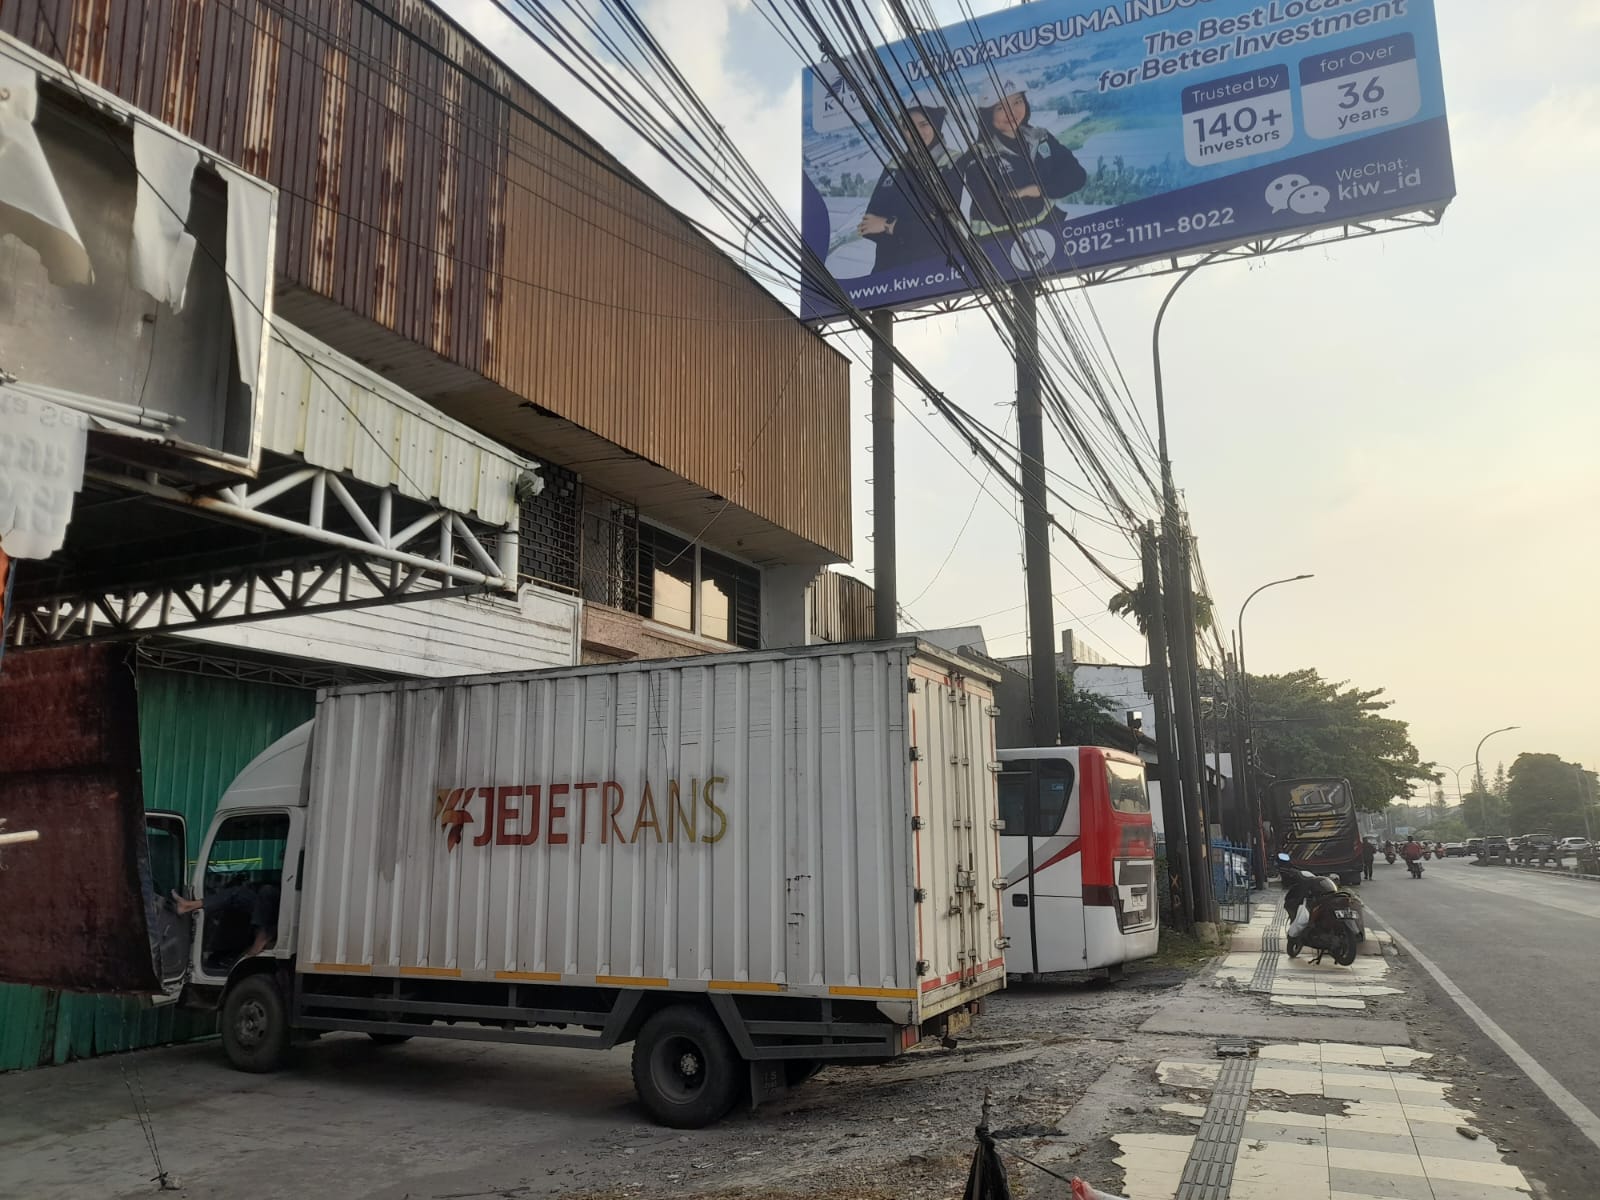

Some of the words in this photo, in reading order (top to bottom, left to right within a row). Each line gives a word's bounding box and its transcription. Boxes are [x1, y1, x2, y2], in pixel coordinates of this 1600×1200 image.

[1099, 68, 1139, 92] for
[1142, 44, 1231, 80] Better
[1236, 0, 1404, 57] Investment
[1146, 29, 1192, 55] The
[1200, 9, 1262, 40] Best
[1319, 58, 1345, 73] for
[1349, 45, 1395, 65] Over
[1192, 75, 1254, 104] Trusted
[1258, 74, 1280, 89] by
[1337, 76, 1385, 110] 36
[1193, 106, 1282, 142] 140+
[1337, 105, 1389, 130] years
[1199, 128, 1280, 157] investors
[1336, 158, 1408, 182] WeChat:
[1338, 168, 1421, 201] kiw_id
[1062, 217, 1124, 239] Contact:
[1064, 207, 1235, 256] 0812-1111-8022
[473, 776, 727, 847] JEJETRANS
